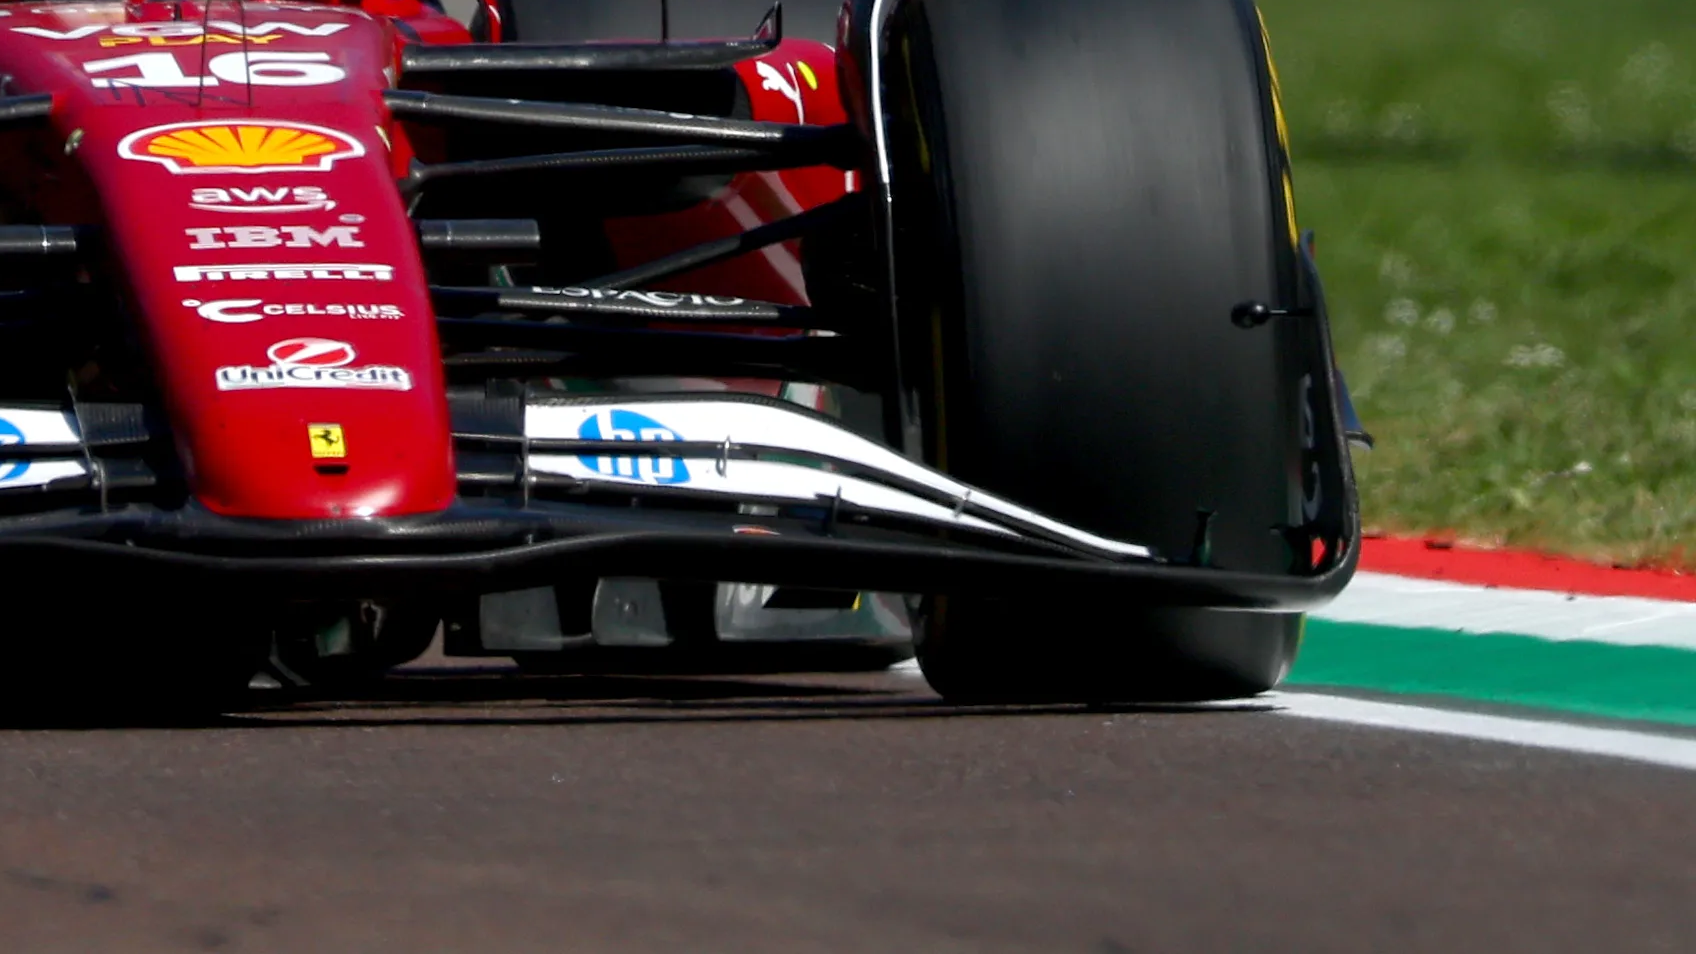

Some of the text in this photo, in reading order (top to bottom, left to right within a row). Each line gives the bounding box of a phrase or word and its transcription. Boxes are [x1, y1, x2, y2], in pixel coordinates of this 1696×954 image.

[99, 33, 283, 47] PLAY
[83, 51, 346, 88] 16
[191, 186, 329, 205] aws
[185, 225, 366, 250] IBM
[173, 263, 393, 282] PIRELLI
[262, 304, 404, 316] CELSIUS
[221, 365, 403, 384] UniCredit
[595, 408, 676, 484] hp
